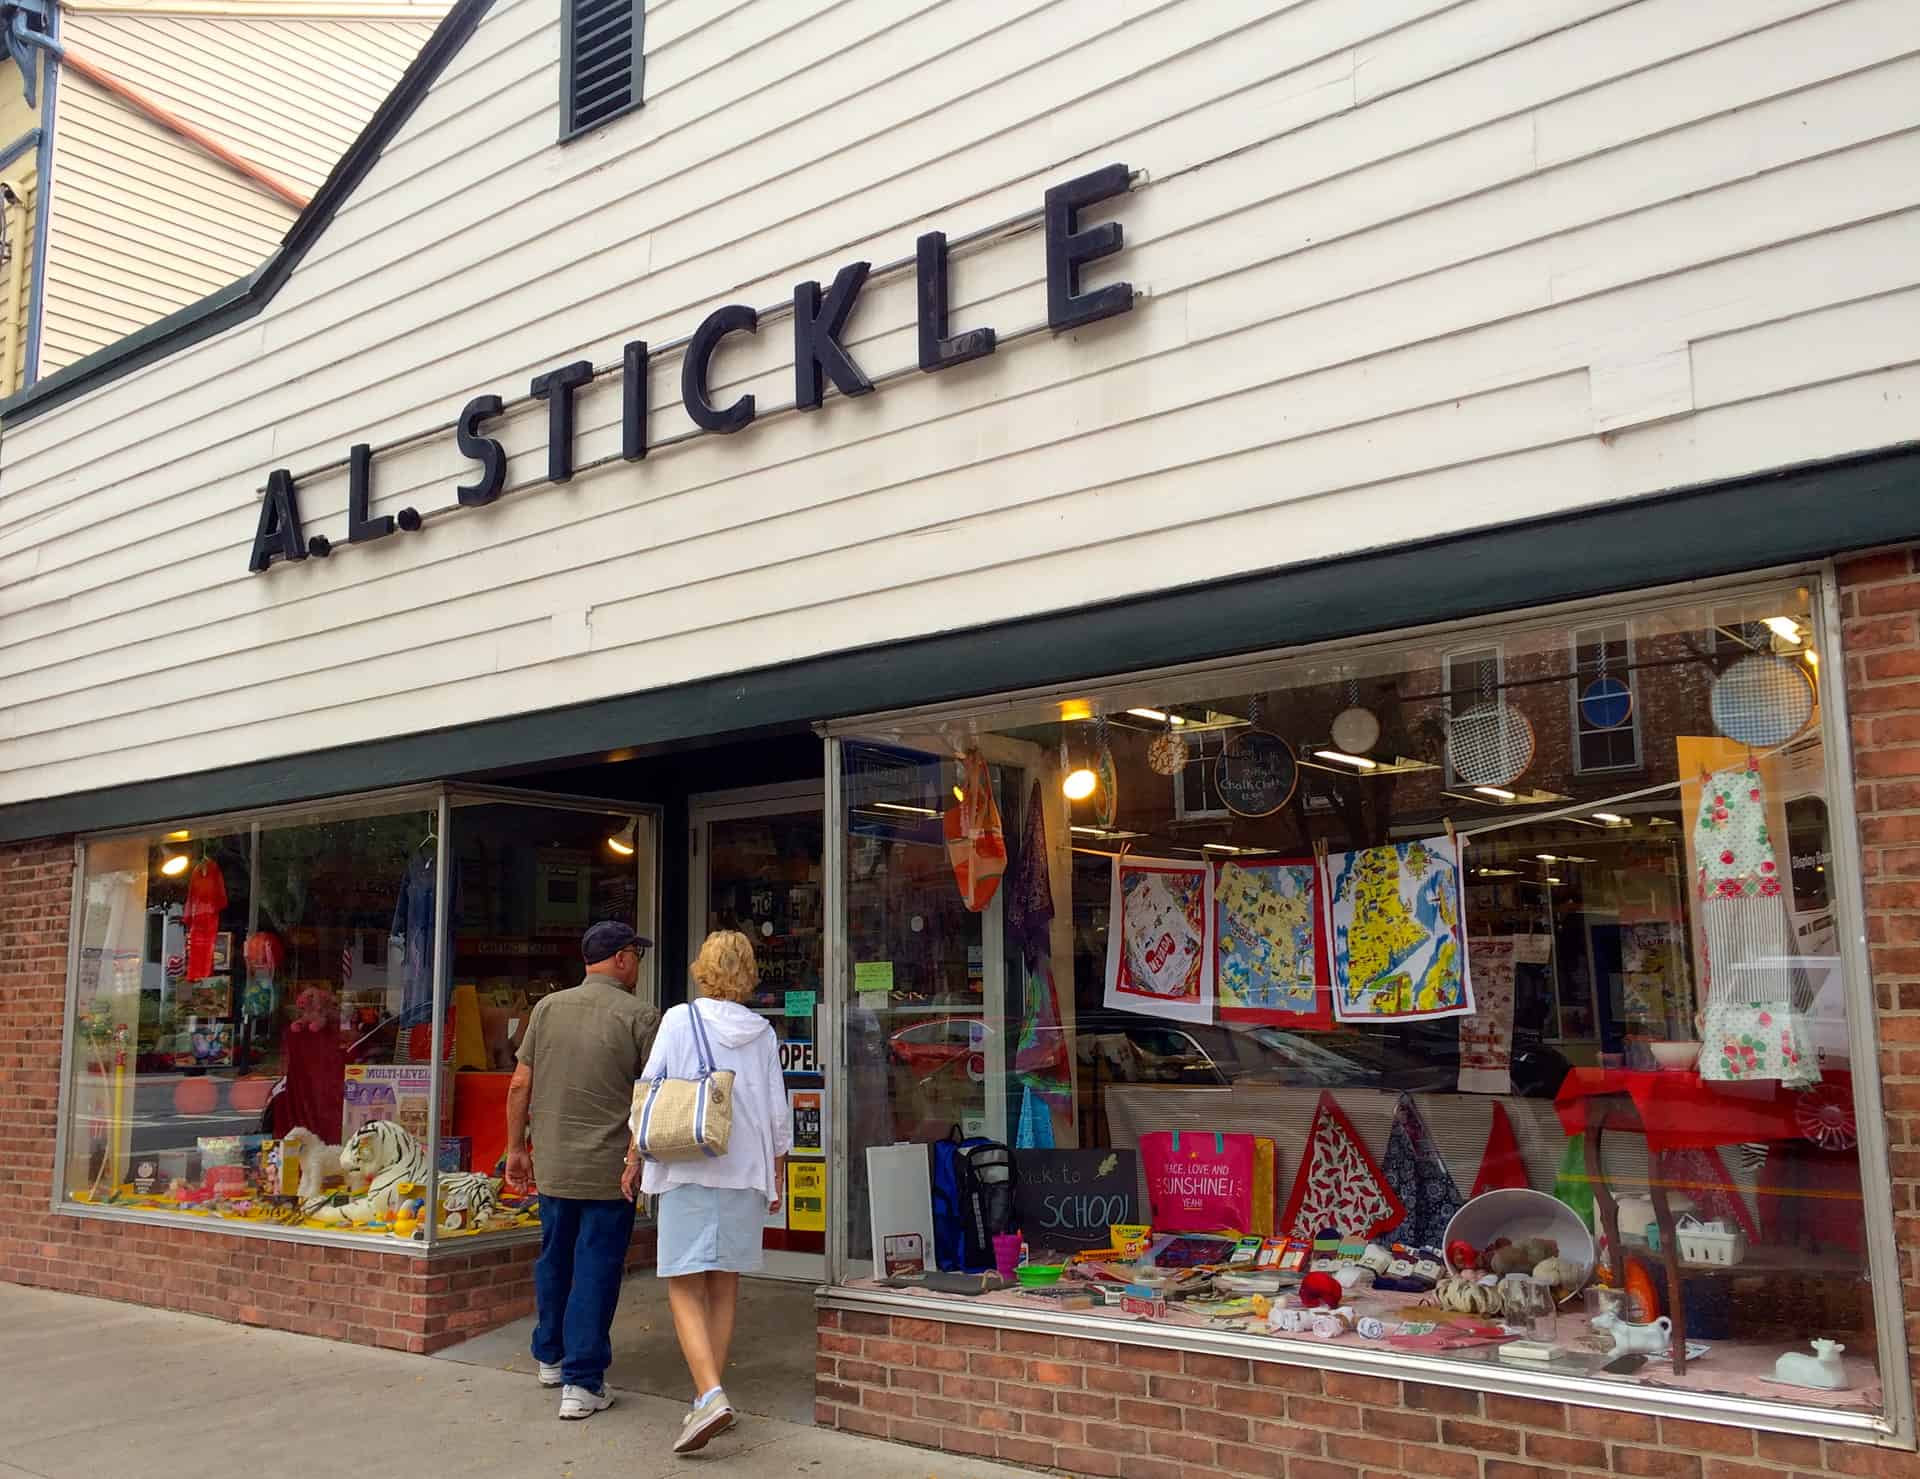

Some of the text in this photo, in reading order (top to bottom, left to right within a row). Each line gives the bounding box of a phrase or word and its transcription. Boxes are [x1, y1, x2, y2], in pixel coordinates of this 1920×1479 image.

[248, 161, 1134, 574] A.L. STICKLE
[1063, 1161, 1081, 1185] to
[1187, 1163, 1210, 1175] LOVE
[1211, 1164, 1230, 1176] AND
[1162, 1176, 1234, 1197] SUNSHINE!
